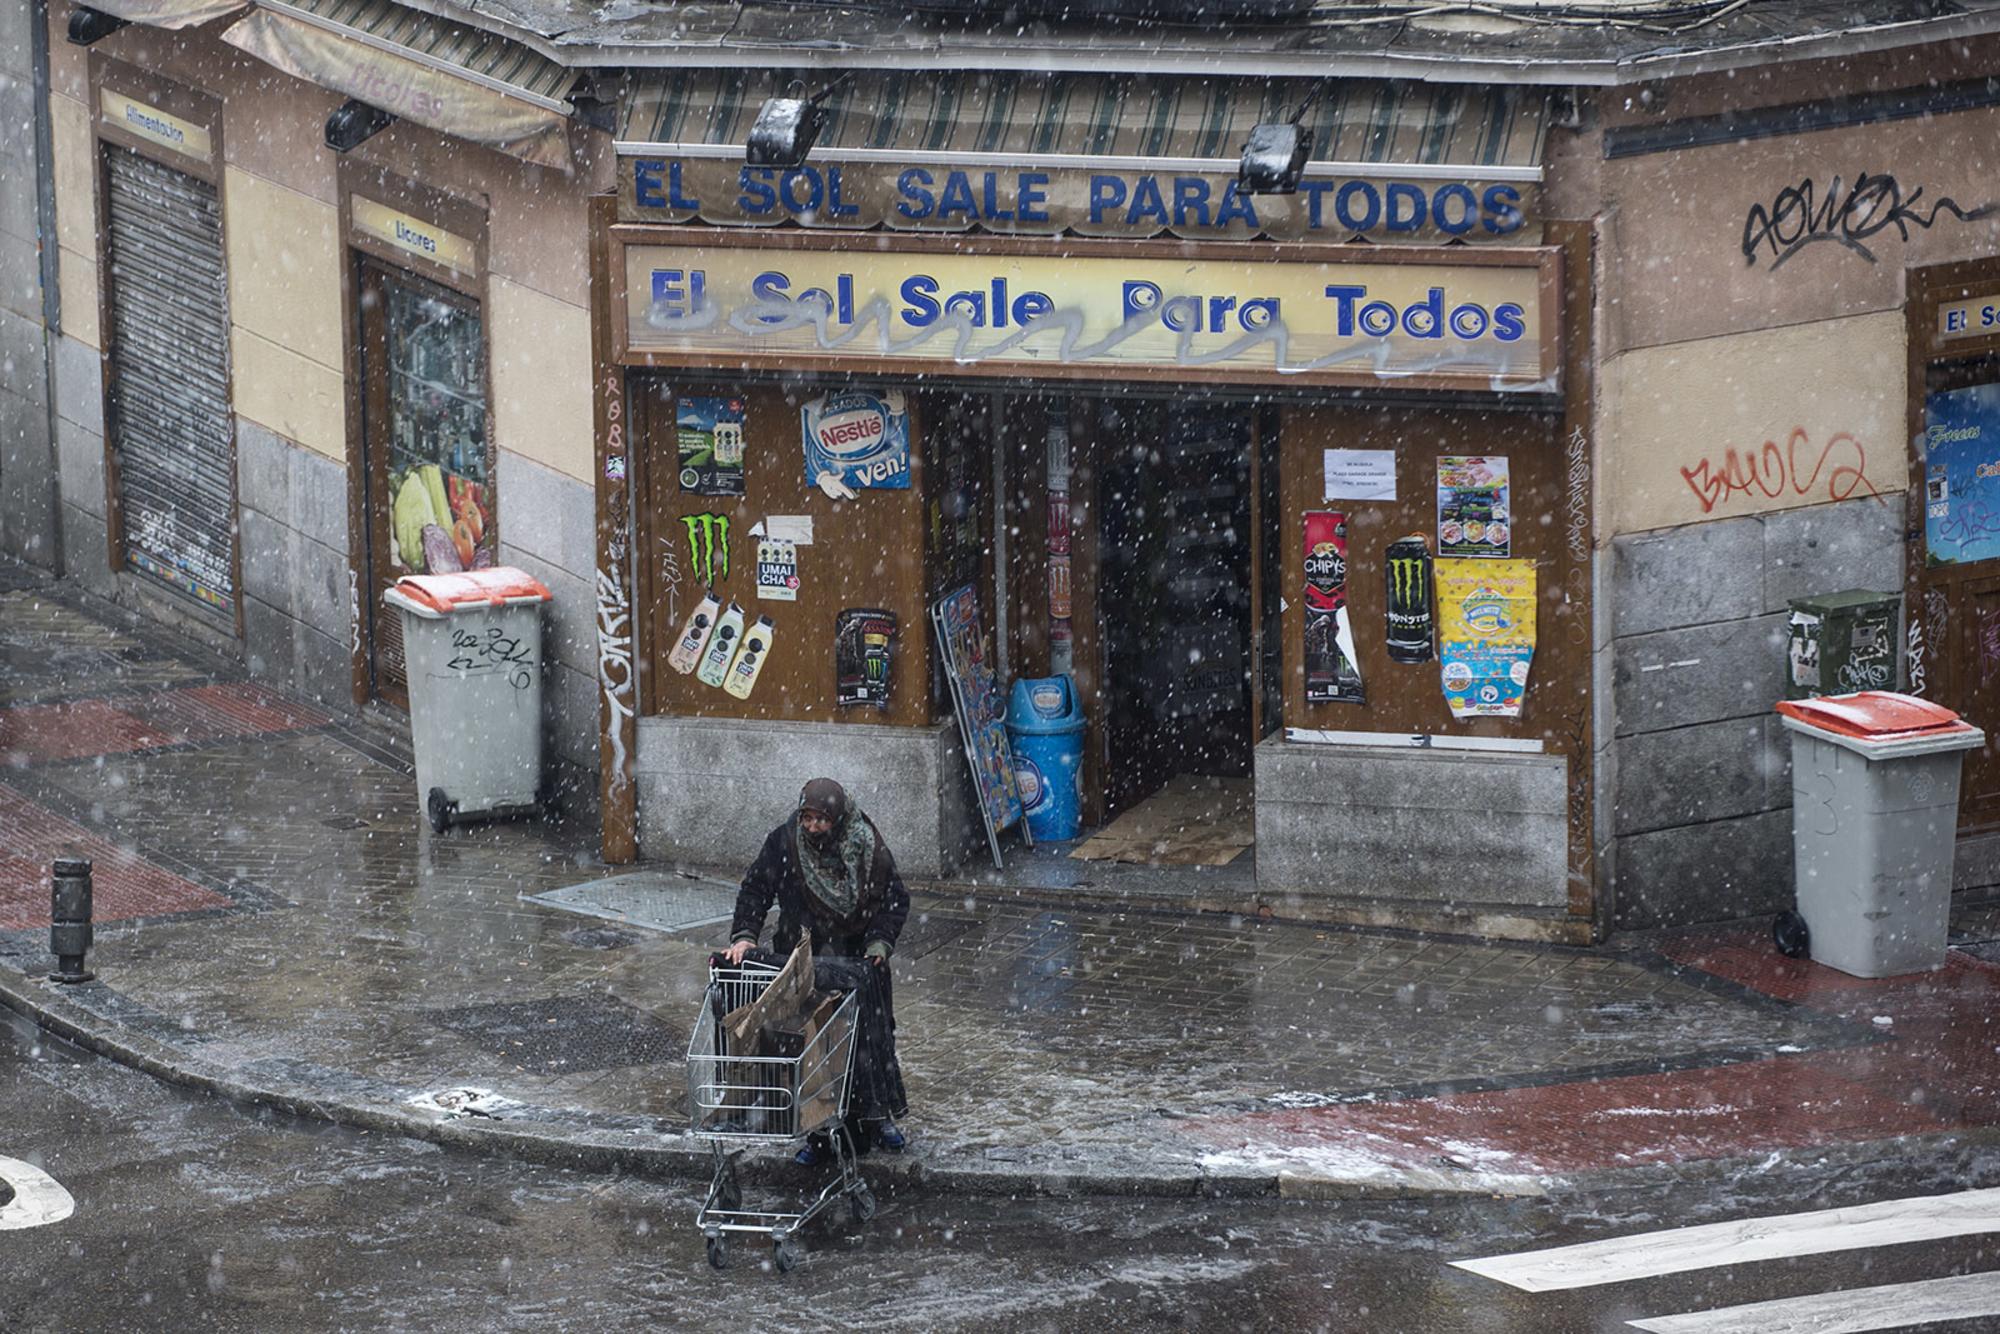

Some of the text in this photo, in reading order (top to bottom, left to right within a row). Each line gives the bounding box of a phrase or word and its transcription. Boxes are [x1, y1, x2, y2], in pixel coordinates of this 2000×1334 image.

[634, 160, 1525, 236] EL SOL SALE PARA TODOS
[395, 220, 437, 253] Licores
[651, 268, 1527, 343] El Sol Sale Para Todos
[1947, 310, 1967, 332] El
[761, 564, 792, 576] UMAI
[1303, 559, 1347, 577] CHIPYS
[761, 574, 787, 586] CHA
